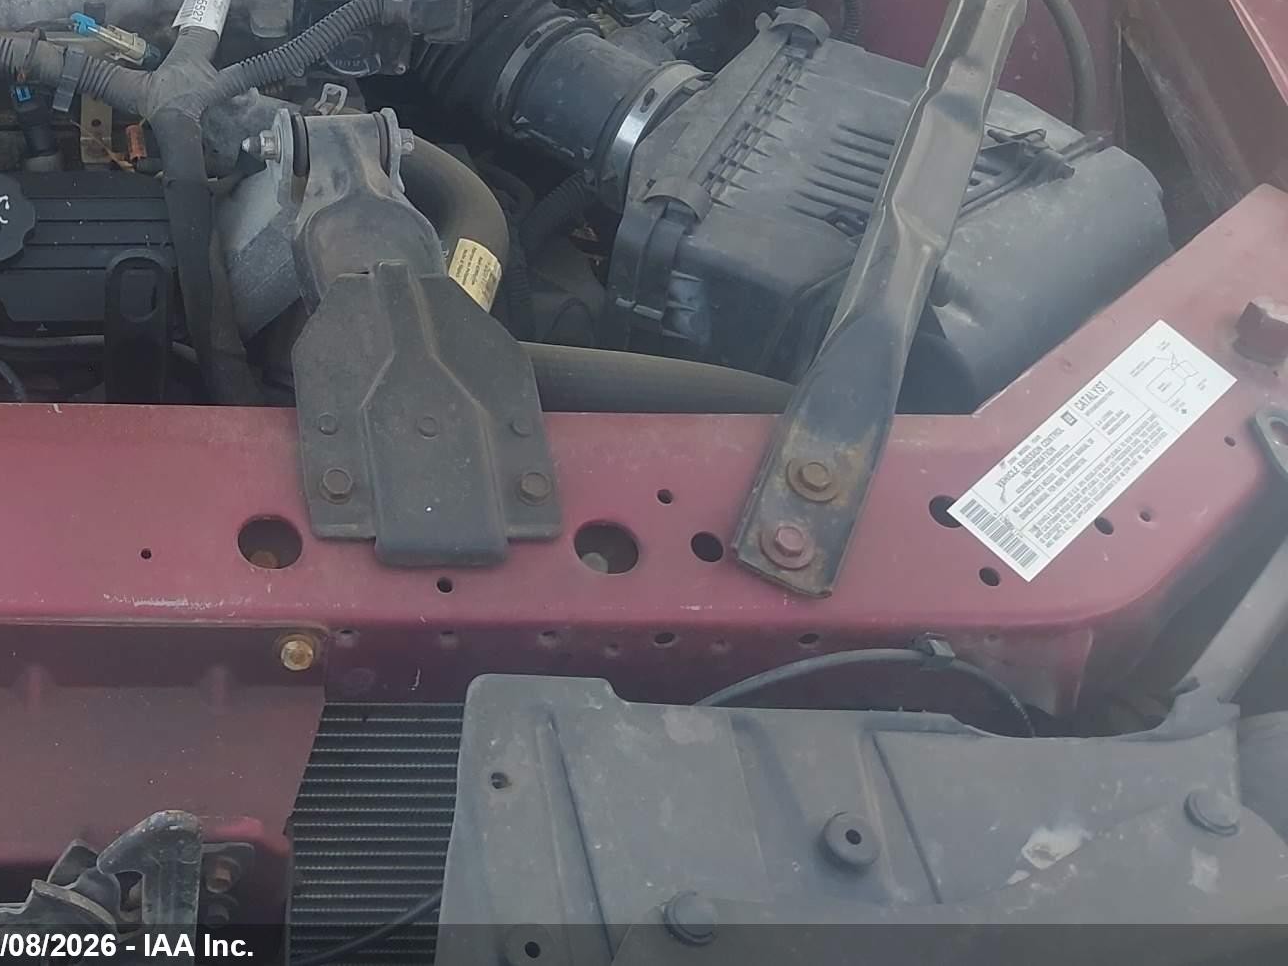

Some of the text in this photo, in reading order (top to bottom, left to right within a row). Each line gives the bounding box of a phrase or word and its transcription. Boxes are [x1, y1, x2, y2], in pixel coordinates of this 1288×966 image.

[1074, 380, 1108, 411] CATALYST
[994, 465, 1020, 489] VEHICLE
[1016, 444, 1043, 469] EMISSION
[1039, 425, 1064, 448] CONTROL
